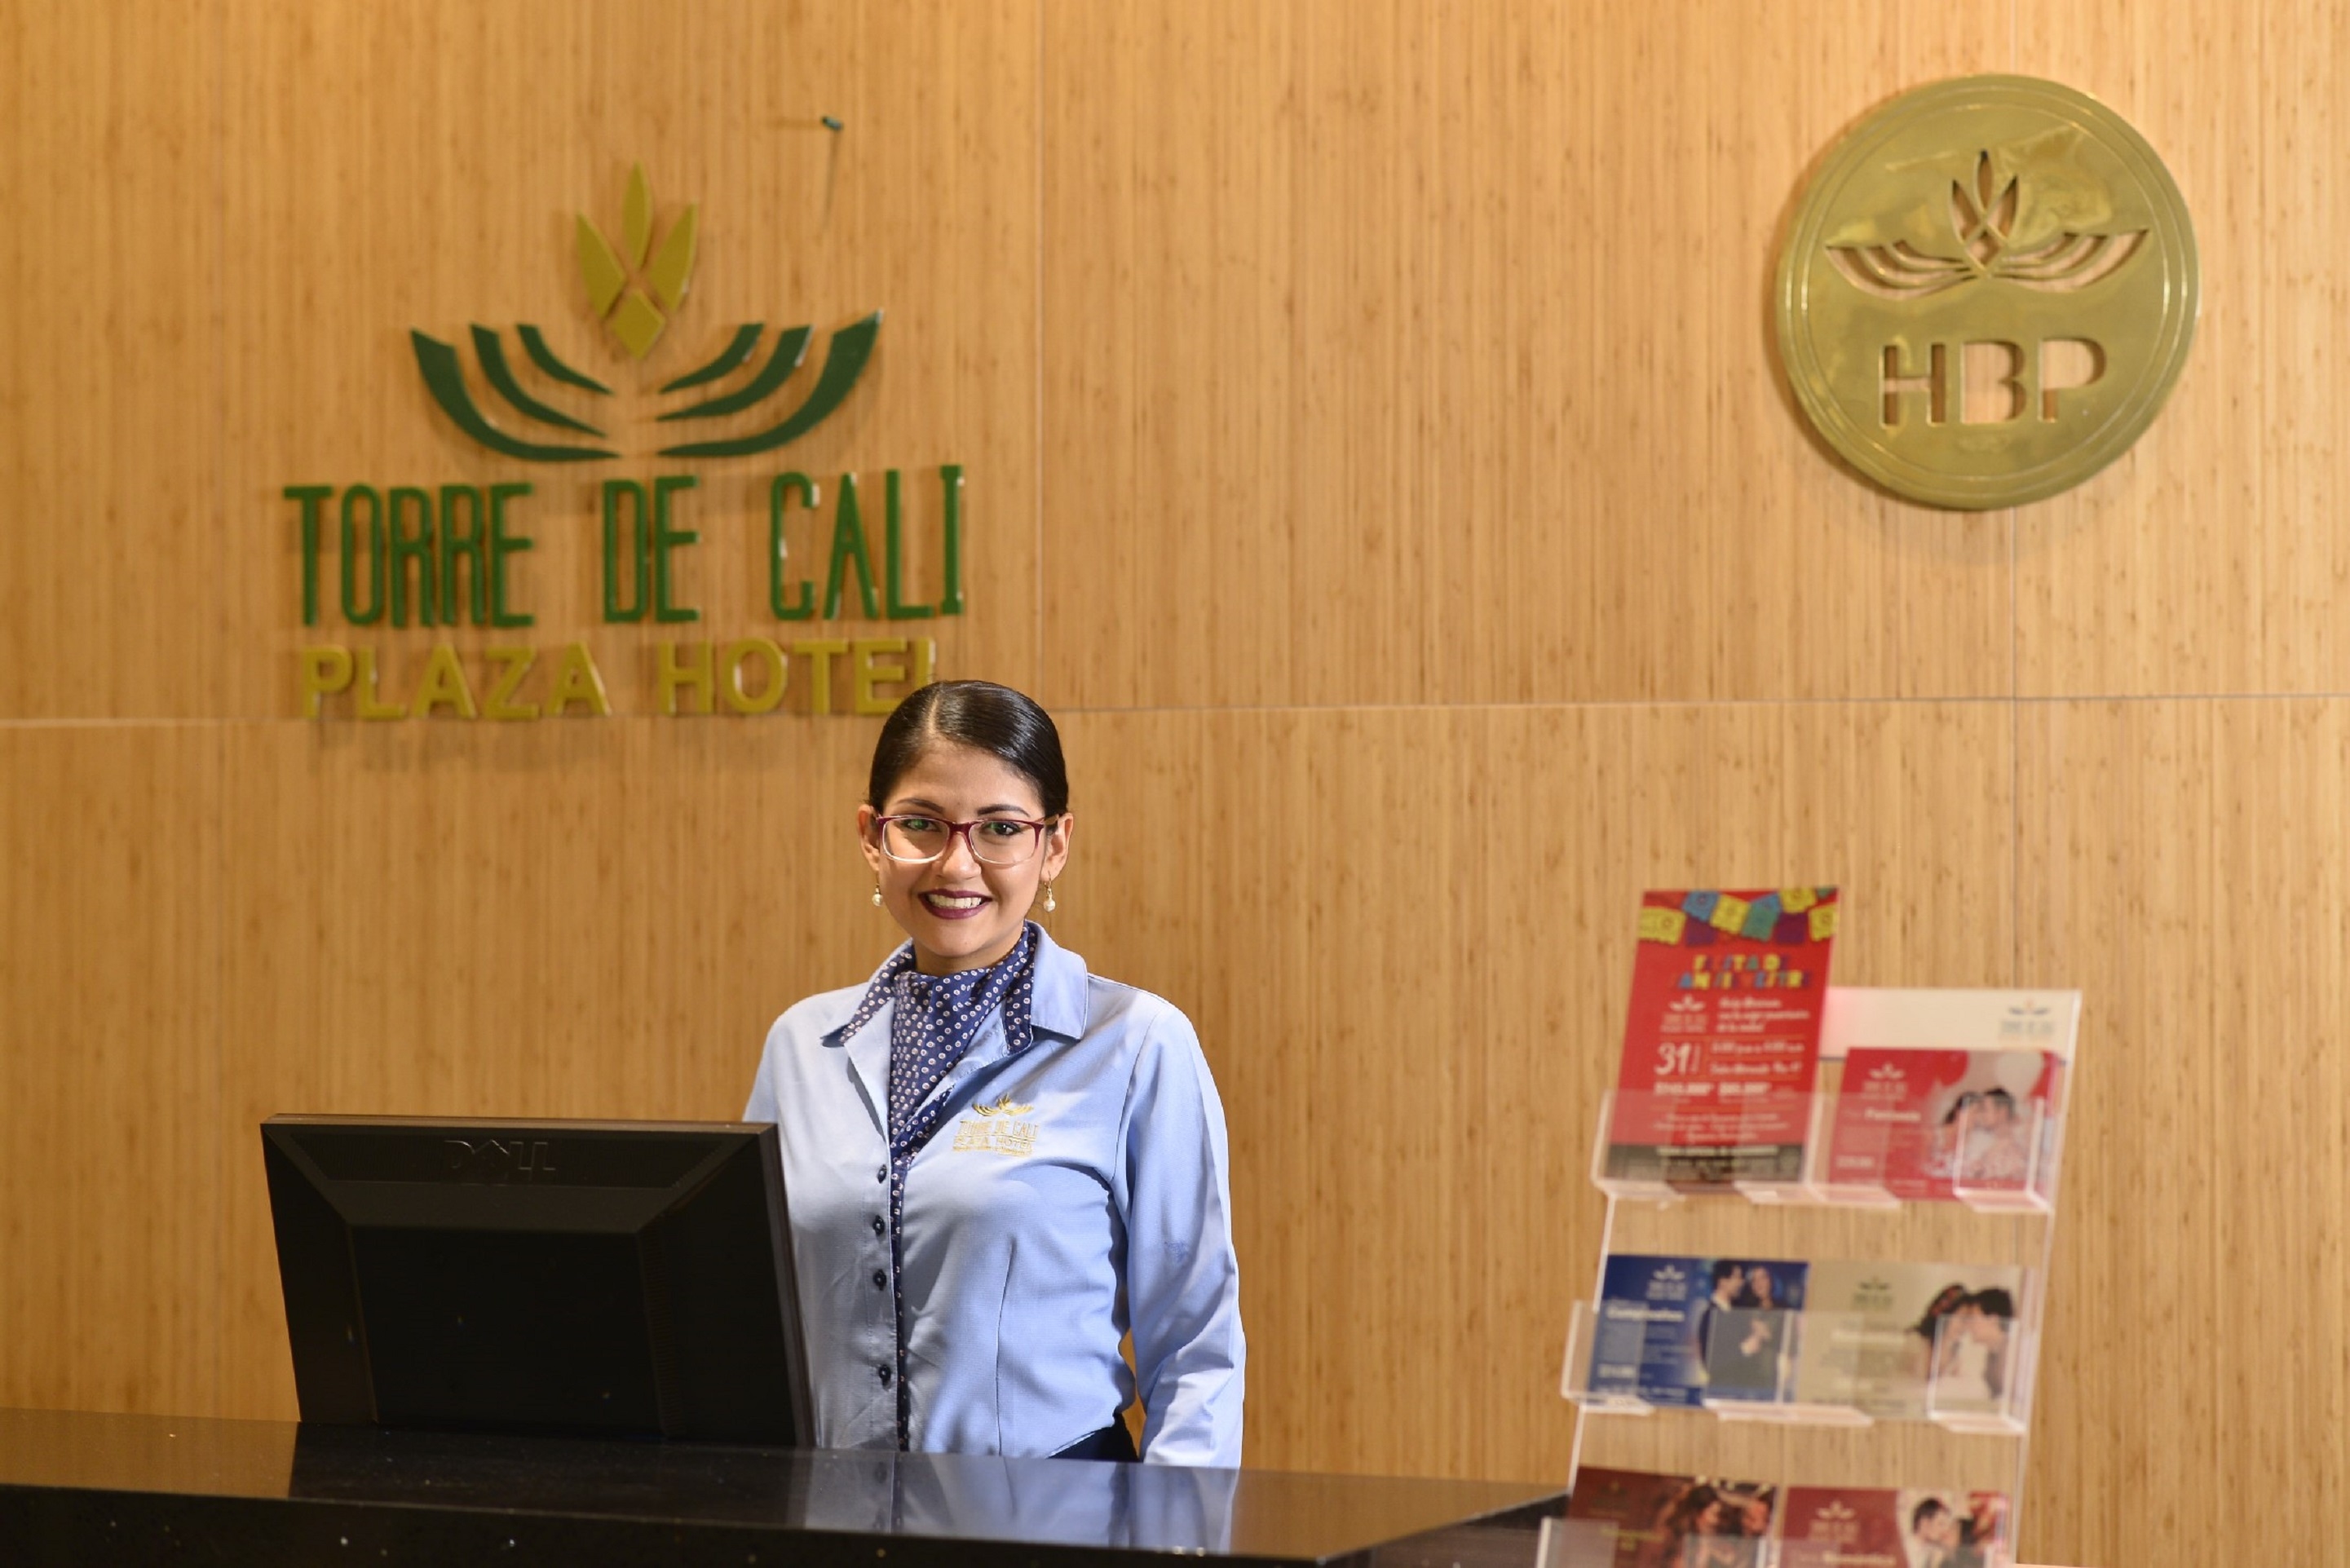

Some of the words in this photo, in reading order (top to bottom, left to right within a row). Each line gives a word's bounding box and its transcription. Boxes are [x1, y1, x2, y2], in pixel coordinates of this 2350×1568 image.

[1879, 336, 2107, 426] HBP
[283, 483, 535, 627] TORRE
[602, 475, 699, 624] DE
[770, 464, 964, 621] CALI
[302, 642, 611, 720] PLAZA
[1654, 1042, 1692, 1075] 31
[1012, 1120, 1039, 1138] CALI
[444, 1139, 558, 1182] DELL
